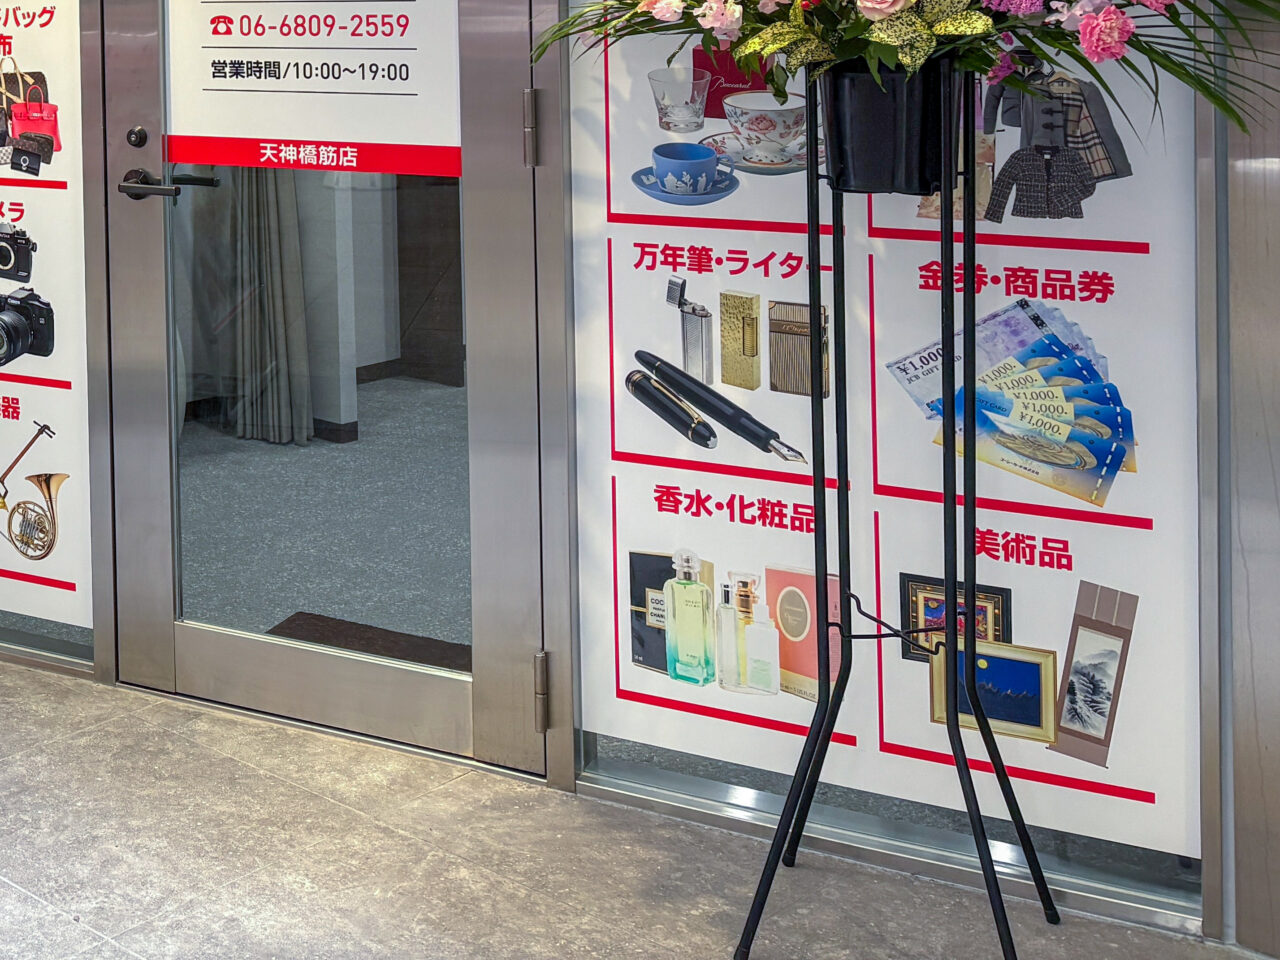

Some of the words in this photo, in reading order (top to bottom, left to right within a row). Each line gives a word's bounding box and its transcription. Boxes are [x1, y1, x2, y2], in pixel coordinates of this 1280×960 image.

[239, 14, 410, 38] 06-6809-2559
[259, 142, 359, 167] 天神橋筋店
[918, 260, 1115, 304] 金券・商品券
[906, 374, 921, 385] JCB
[922, 365, 940, 378] GIFT
[653, 484, 815, 535] 香水・化粧品
[974, 527, 1073, 572] 美術品
